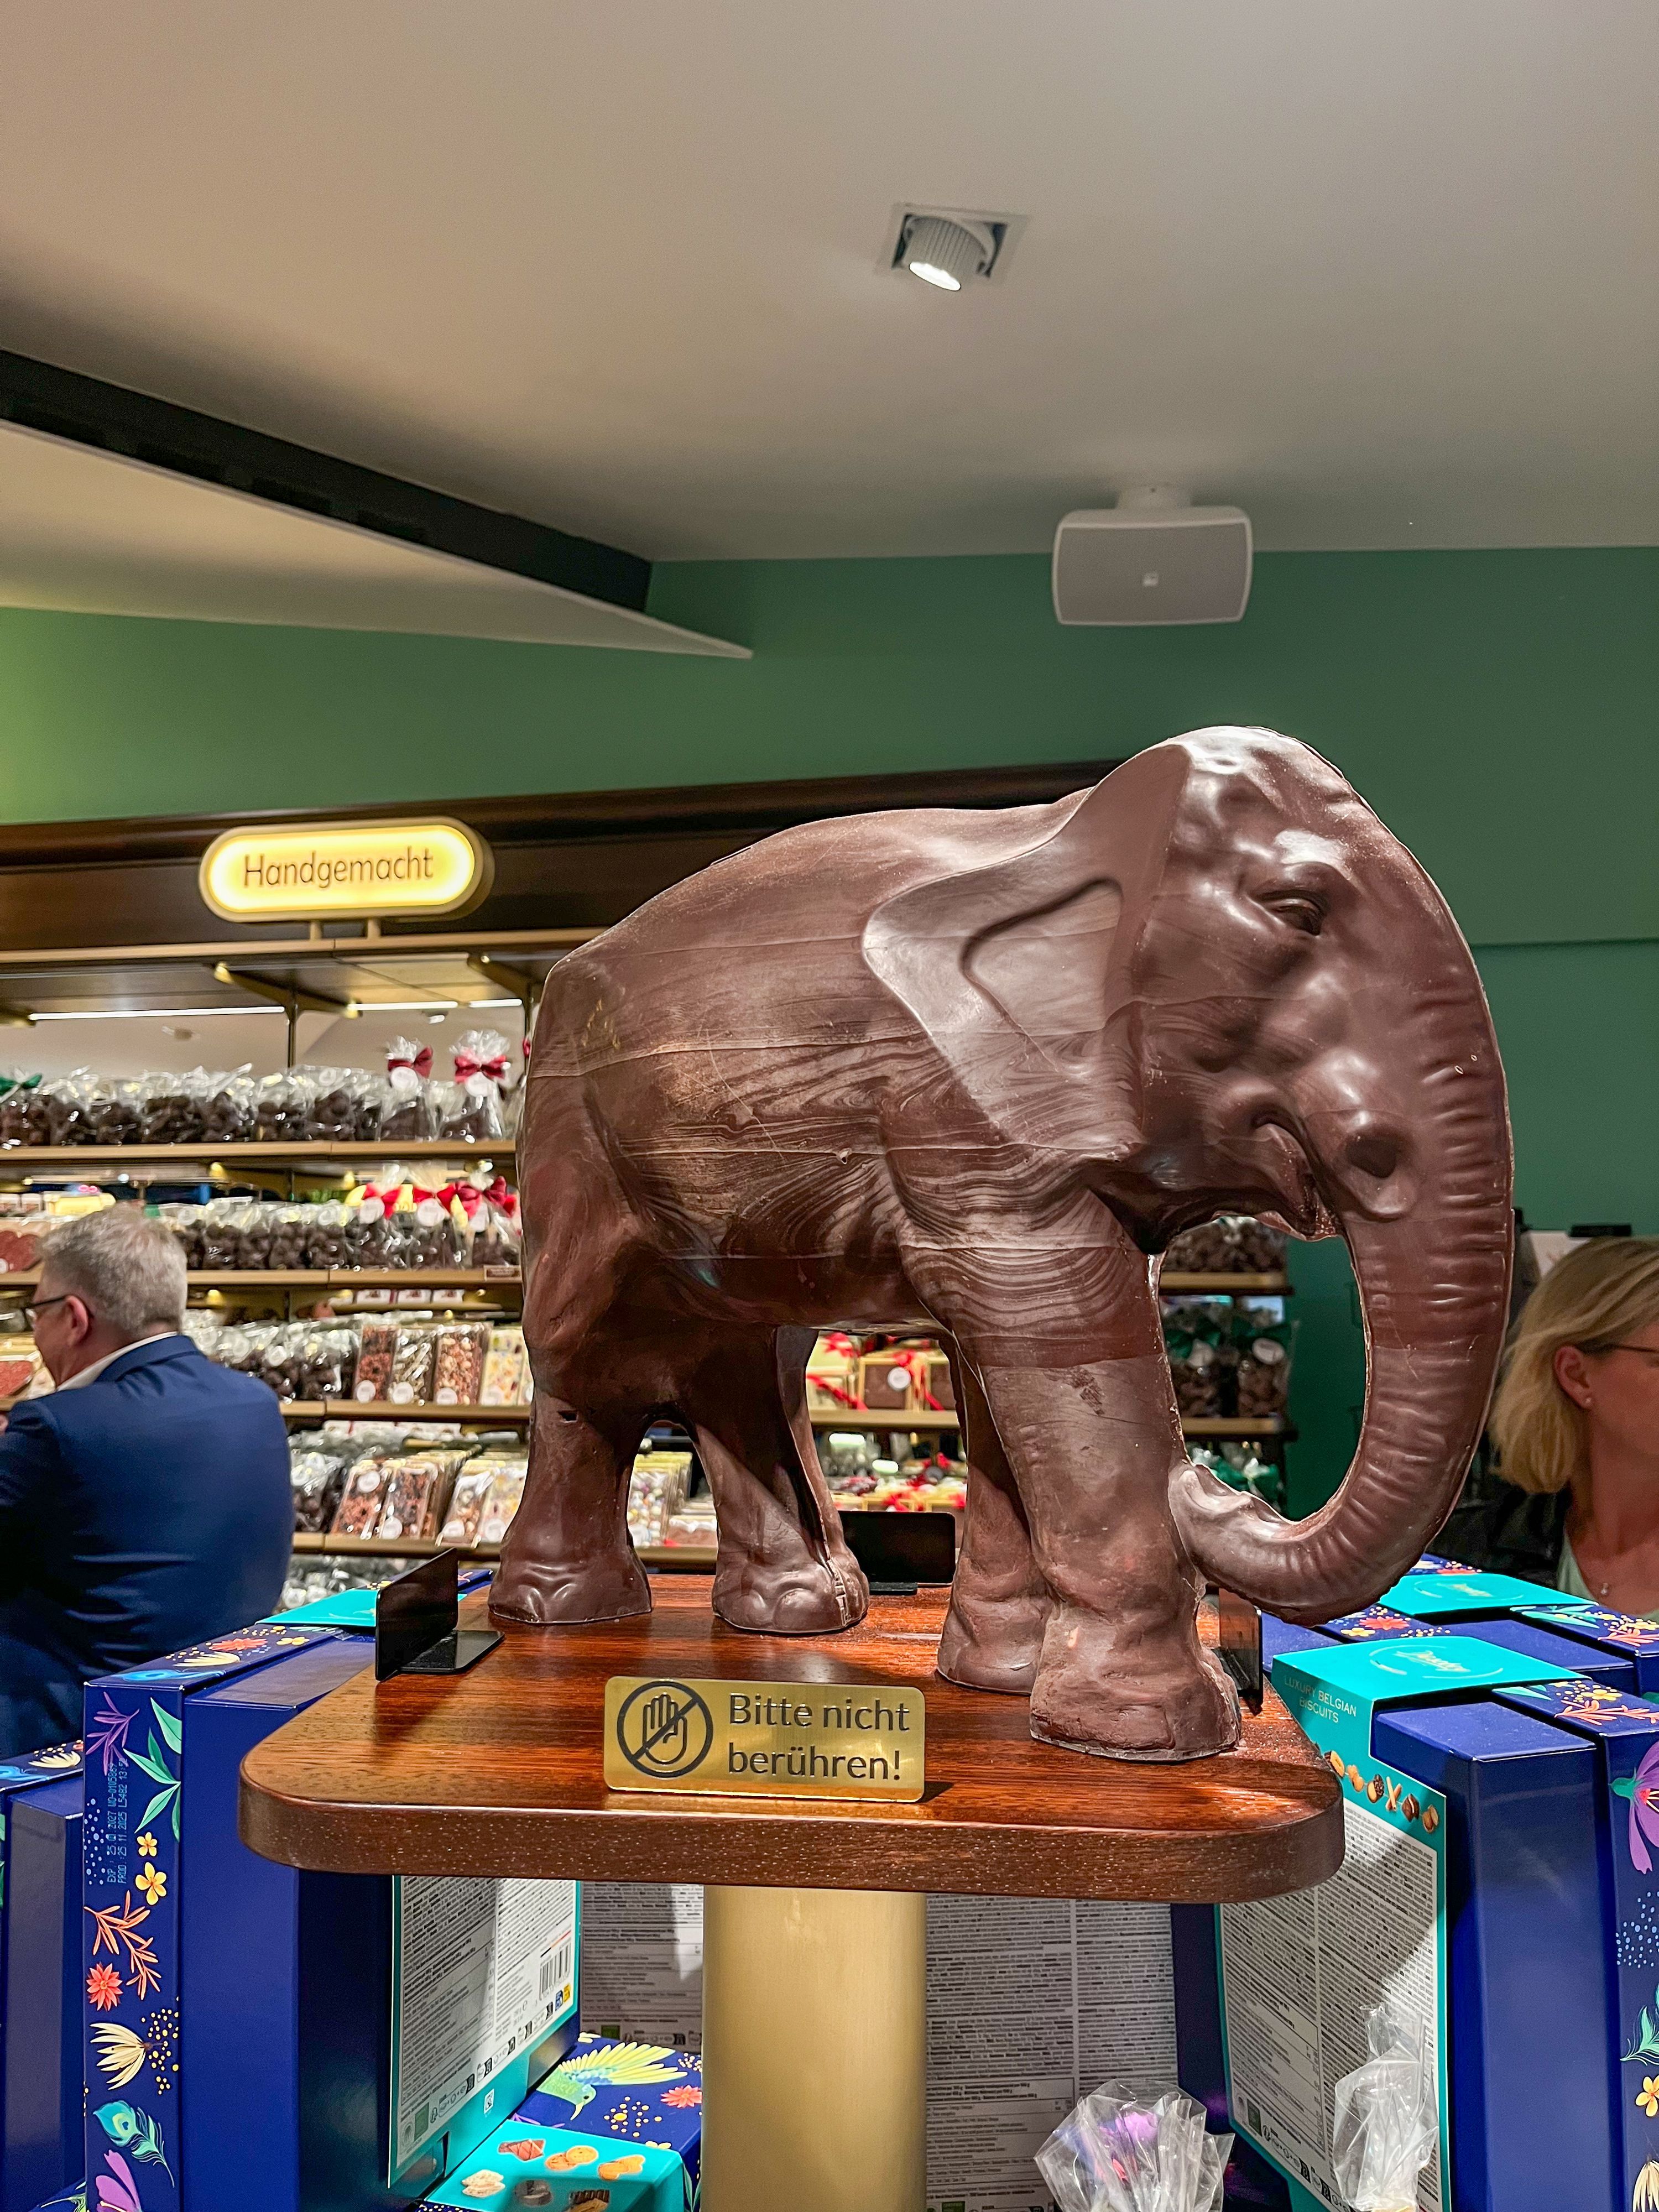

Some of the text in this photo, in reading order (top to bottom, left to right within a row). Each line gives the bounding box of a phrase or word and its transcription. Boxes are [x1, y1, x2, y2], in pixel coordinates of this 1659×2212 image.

[244, 846, 434, 890] Handgemacht
[729, 1692, 910, 1731] Bitte nicht
[1284, 1676, 1357, 1717] LUXURY BELGIAN
[1299, 1696, 1339, 1723] BISCUITS
[728, 1742, 901, 1781] berühren!
